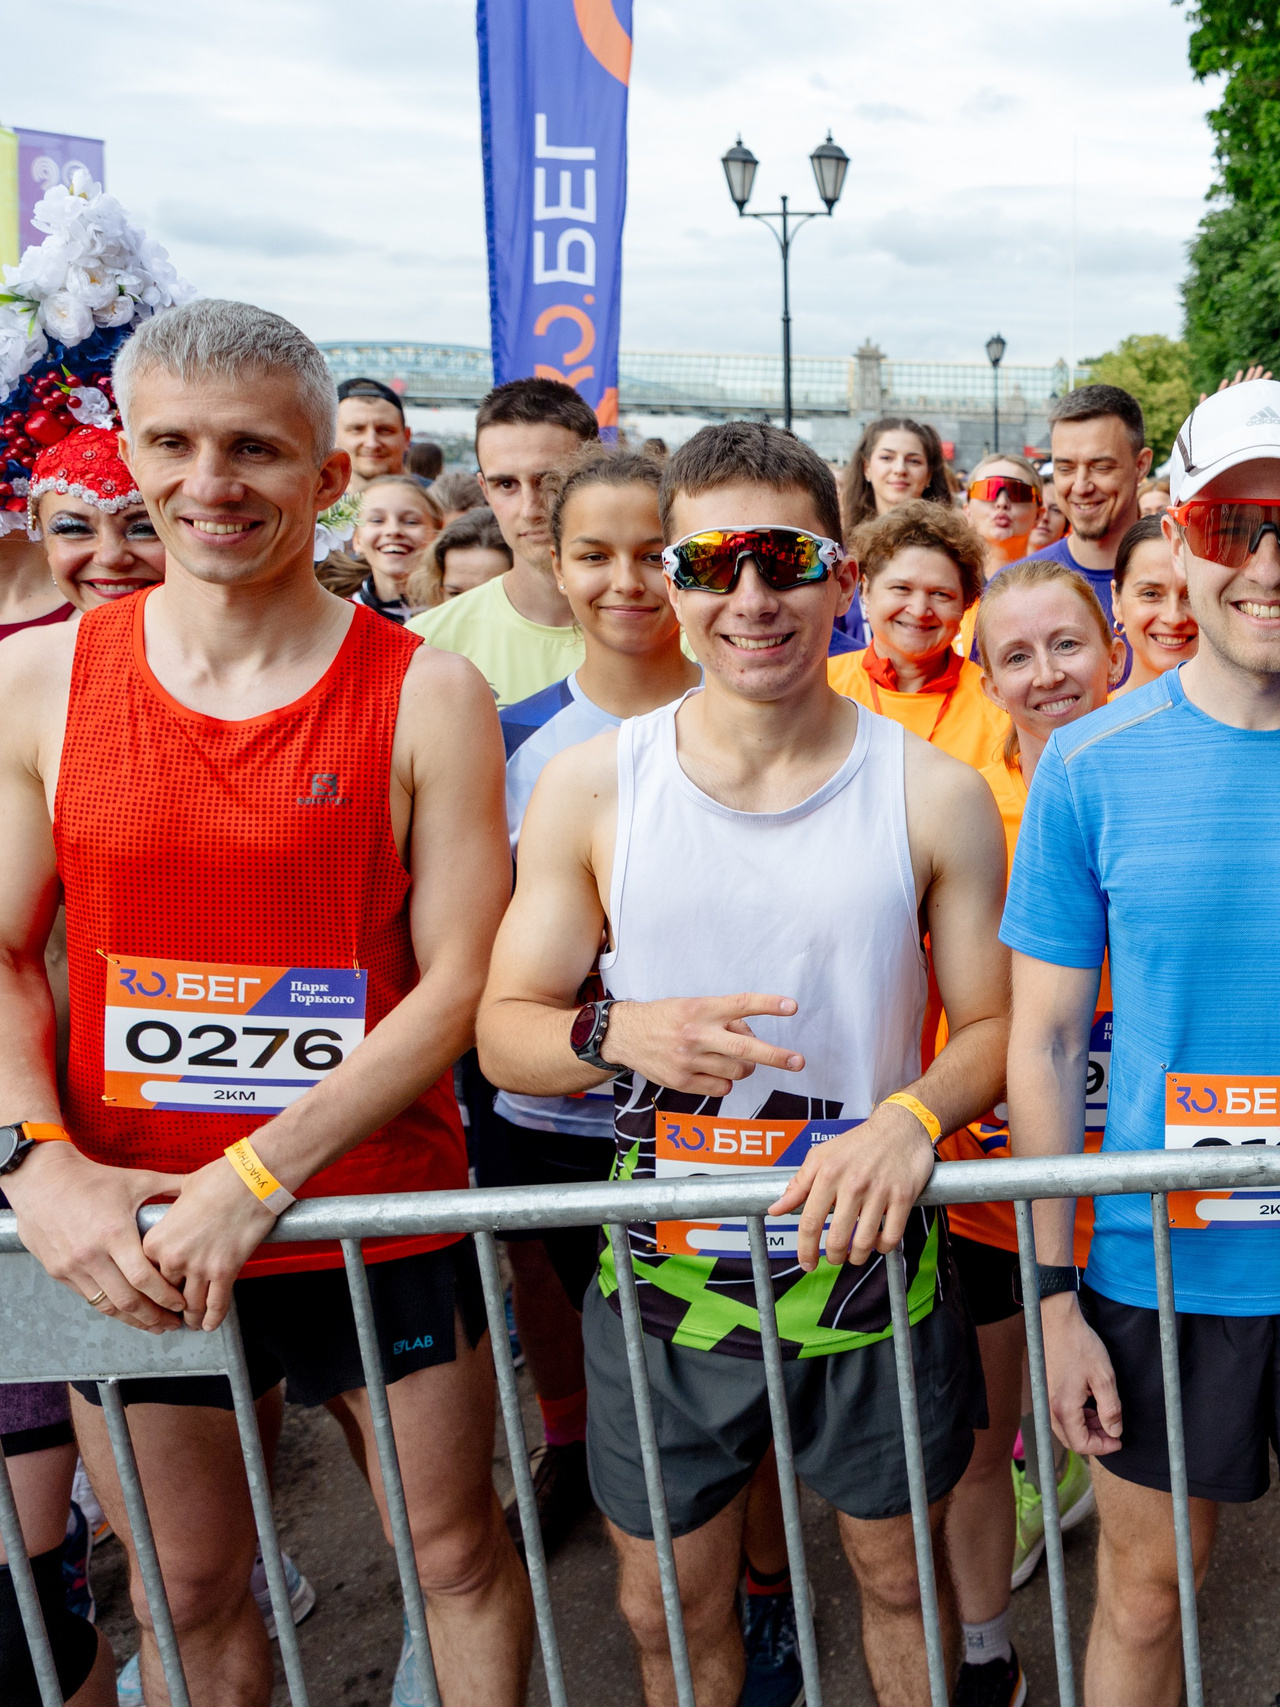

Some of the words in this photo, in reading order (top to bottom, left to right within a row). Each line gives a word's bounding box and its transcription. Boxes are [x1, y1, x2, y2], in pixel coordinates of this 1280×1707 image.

[290, 981, 330, 994] Парк
[289, 993, 356, 1006] Горького
[125, 1019, 344, 1071] 0276
